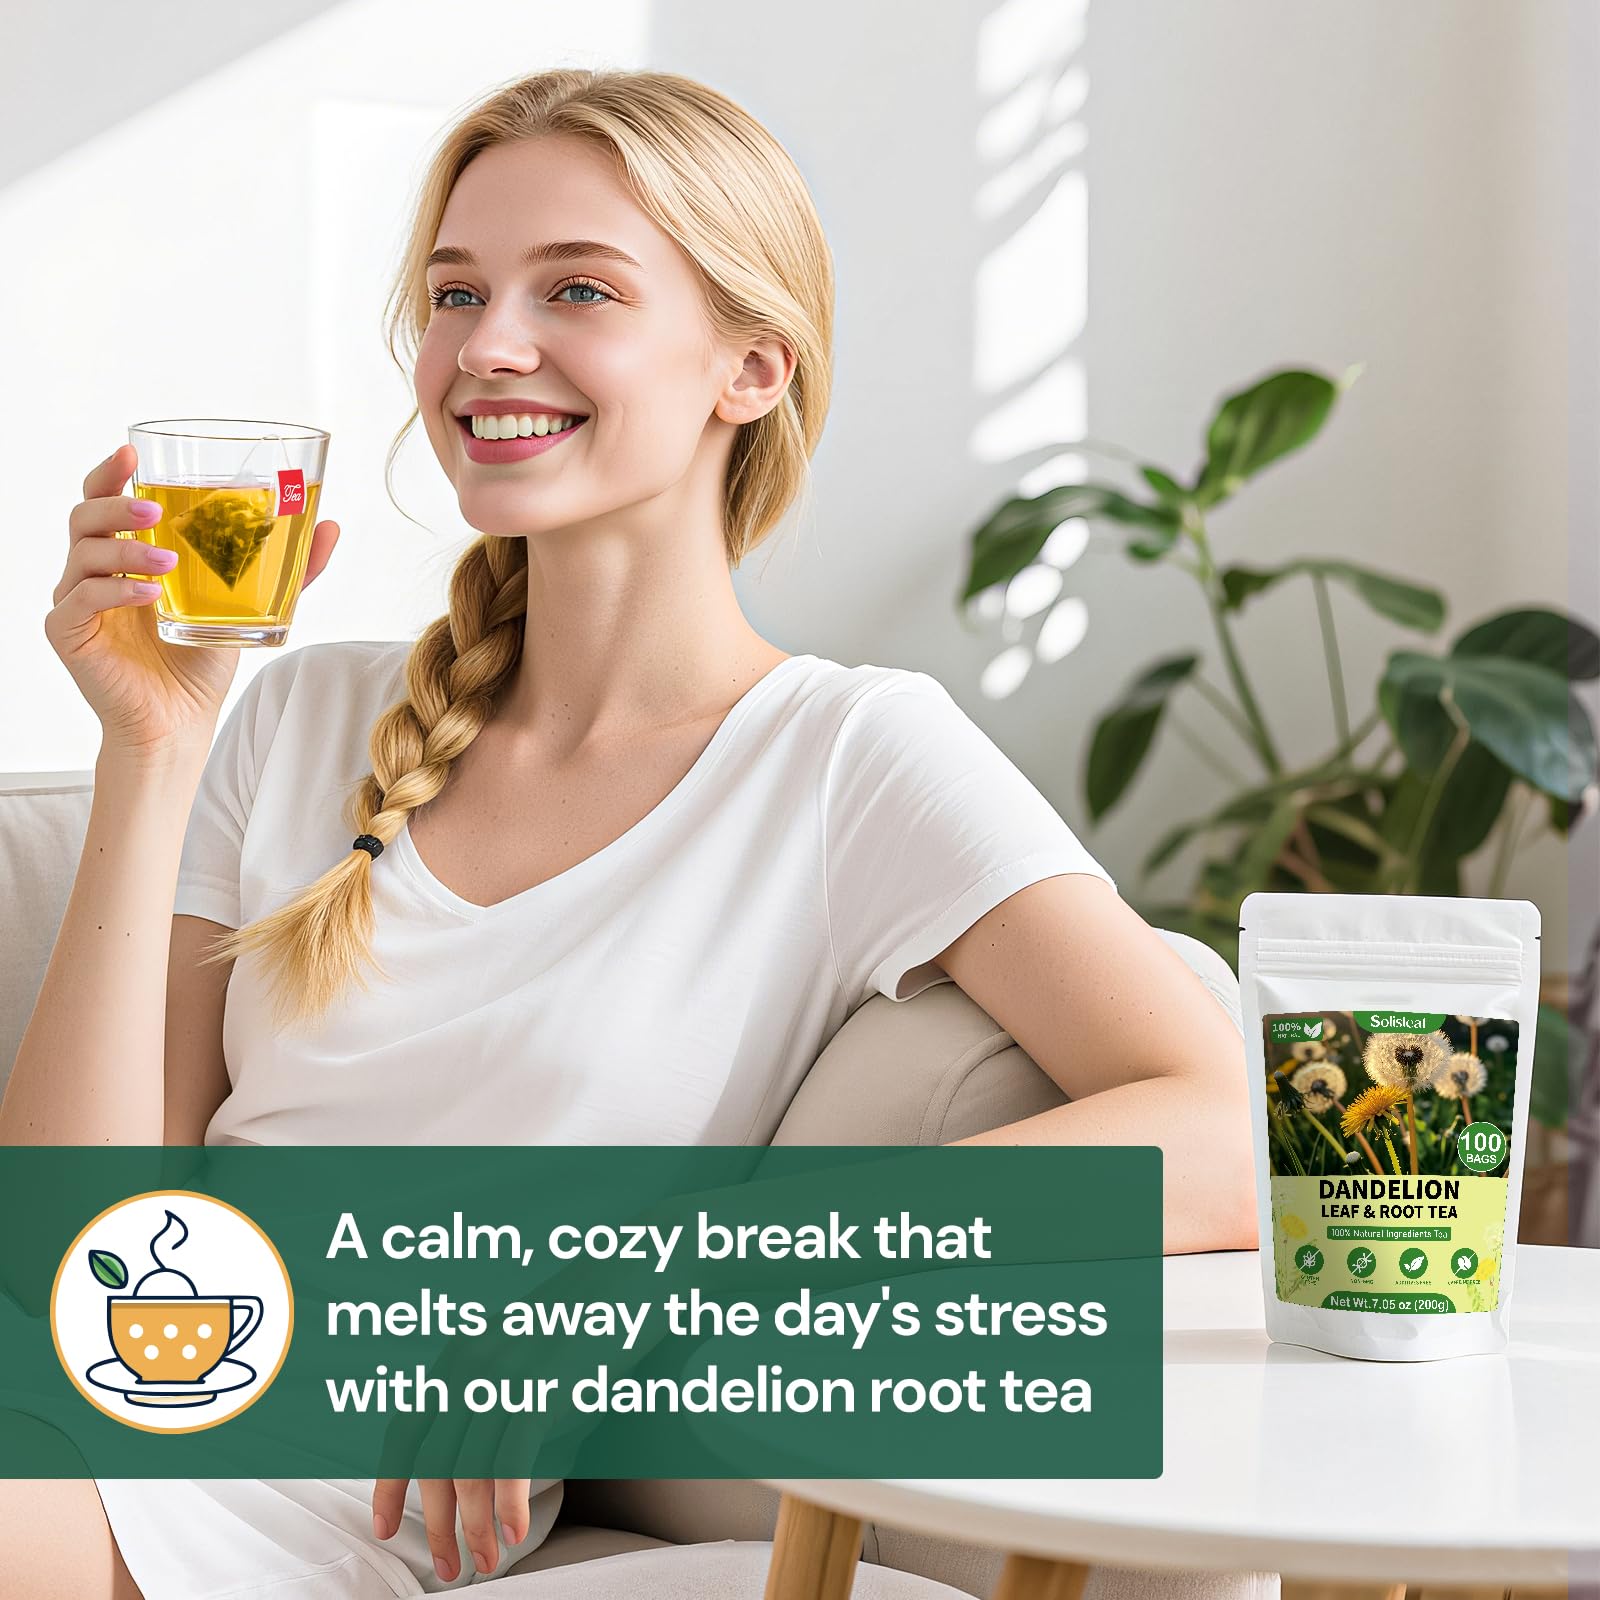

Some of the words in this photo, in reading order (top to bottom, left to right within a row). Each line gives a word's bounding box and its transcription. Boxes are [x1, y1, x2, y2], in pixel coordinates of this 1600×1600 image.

[283, 484, 302, 503] Tea
[1272, 1022, 1302, 1033] 100%
[1460, 1132, 1501, 1152] 100
[1466, 1153, 1497, 1164] BAGS
[1319, 1179, 1460, 1200] DANDELION
[1321, 1204, 1360, 1219] LEAF
[1363, 1204, 1376, 1219] &
[1380, 1204, 1424, 1219] ROOT
[1427, 1204, 1458, 1219] TEA
[1331, 1228, 1351, 1237] 100%
[1353, 1229, 1384, 1238] Natural
[1386, 1229, 1432, 1240] Ingredients
[1434, 1229, 1448, 1239] Tea
[1330, 1295, 1351, 1308] Net
[1398, 1301, 1412, 1310] oz
[1414, 1299, 1449, 1313] (200g)
